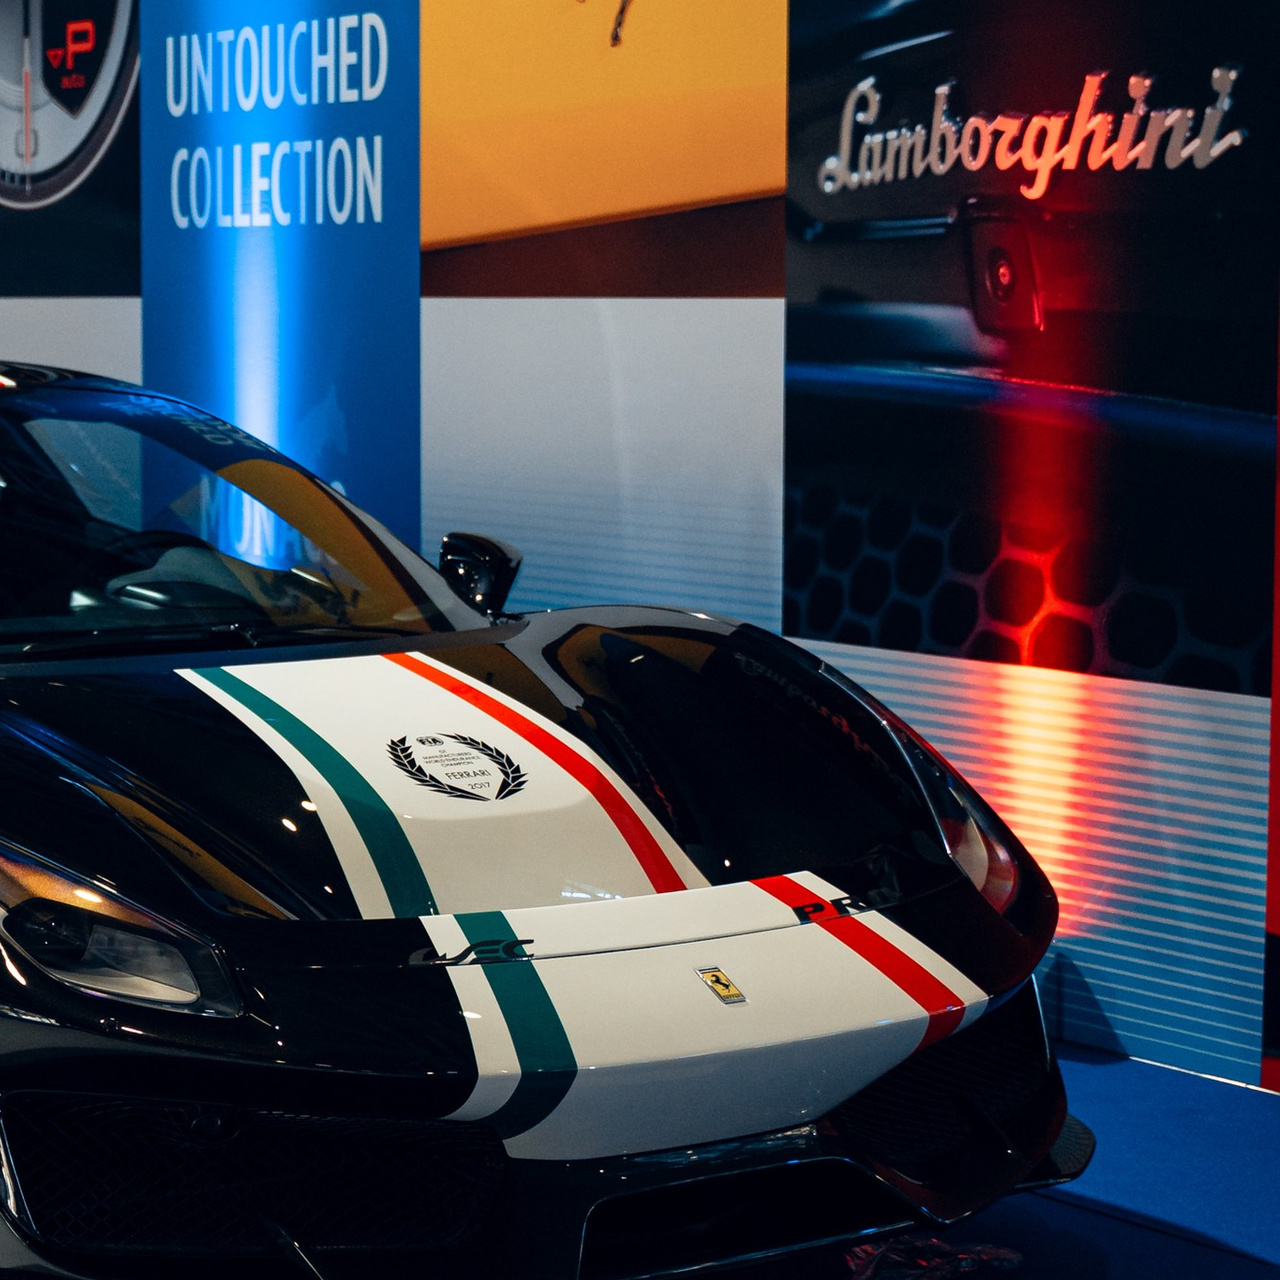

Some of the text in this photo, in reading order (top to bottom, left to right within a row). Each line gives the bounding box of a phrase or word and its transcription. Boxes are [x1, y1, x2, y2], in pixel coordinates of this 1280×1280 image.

[65, 19, 96, 69] P
[166, 13, 389, 118] UNTOUCHED
[819, 66, 1247, 200] Lamborghini
[171, 135, 383, 229] COLLECTION
[445, 769, 491, 780] FERRARI
[468, 782, 490, 790] 2017
